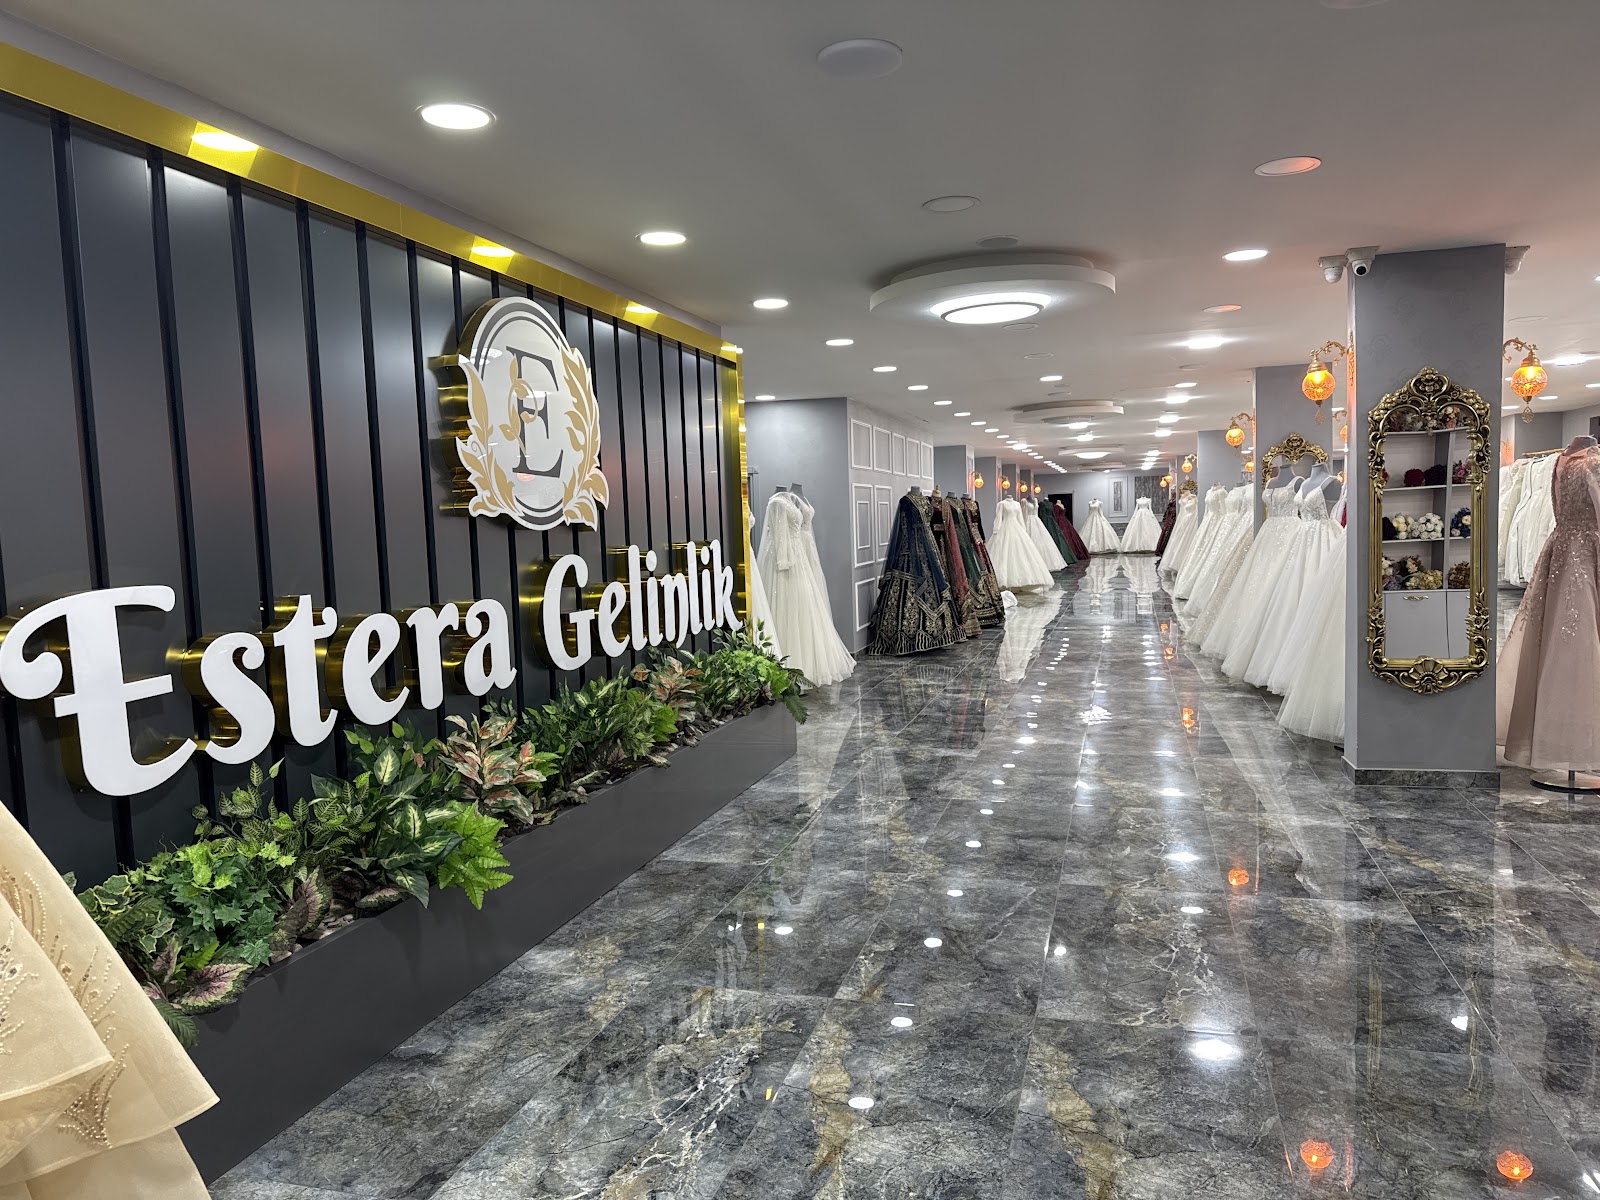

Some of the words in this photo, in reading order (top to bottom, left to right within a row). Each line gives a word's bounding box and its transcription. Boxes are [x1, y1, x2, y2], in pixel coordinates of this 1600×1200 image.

[506, 346, 564, 478] E
[0, 585, 517, 796] Estera
[543, 539, 744, 671] Gelinlik
